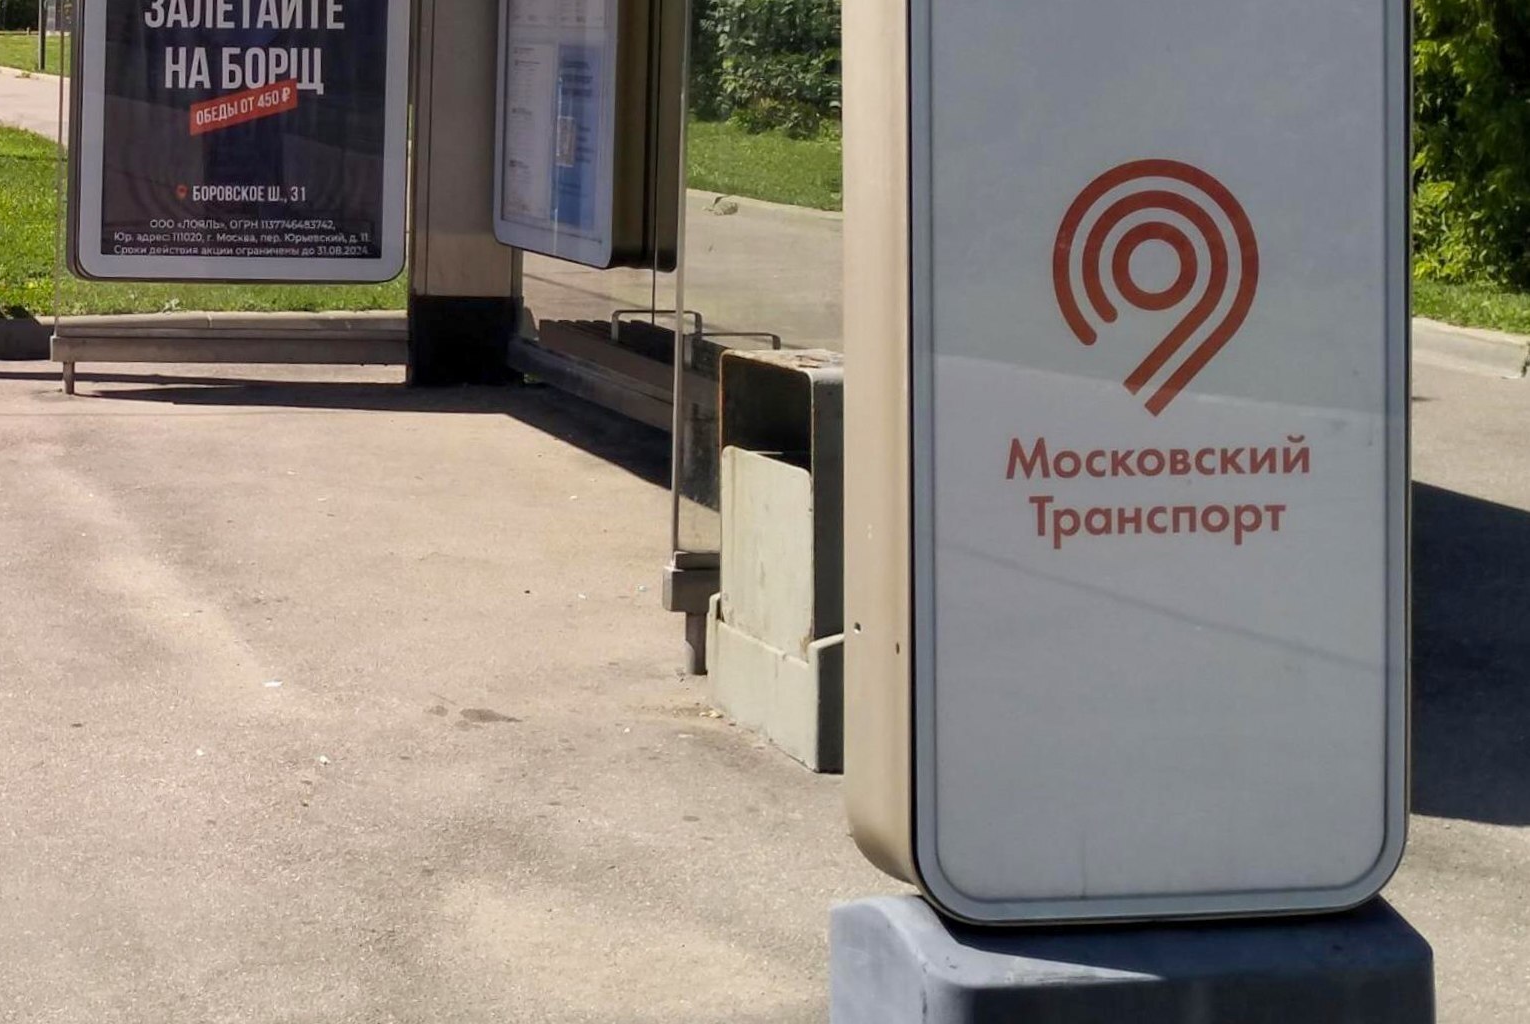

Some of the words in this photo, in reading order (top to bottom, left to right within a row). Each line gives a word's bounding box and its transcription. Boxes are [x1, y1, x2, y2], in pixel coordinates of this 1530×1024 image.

[164, 46, 211, 90] НА
[221, 46, 325, 96] БОРЩ
[195, 102, 239, 126] ОБЕДЫ
[240, 98, 255, 114] ОТ
[192, 184, 265, 202] БОРОВСКОЕ
[290, 185, 307, 202] 31
[149, 219, 175, 229] ООО
[229, 219, 259, 230] ОГРН
[113, 232, 134, 243] Юр.
[216, 233, 258, 244] Москва,
[113, 245, 147, 256] Сроки
[148, 245, 198, 256] действия
[201, 246, 233, 257] акции
[235, 246, 300, 257] ограничены
[1004, 434, 1311, 481] Московский
[1028, 495, 1286, 550] Транспорт
